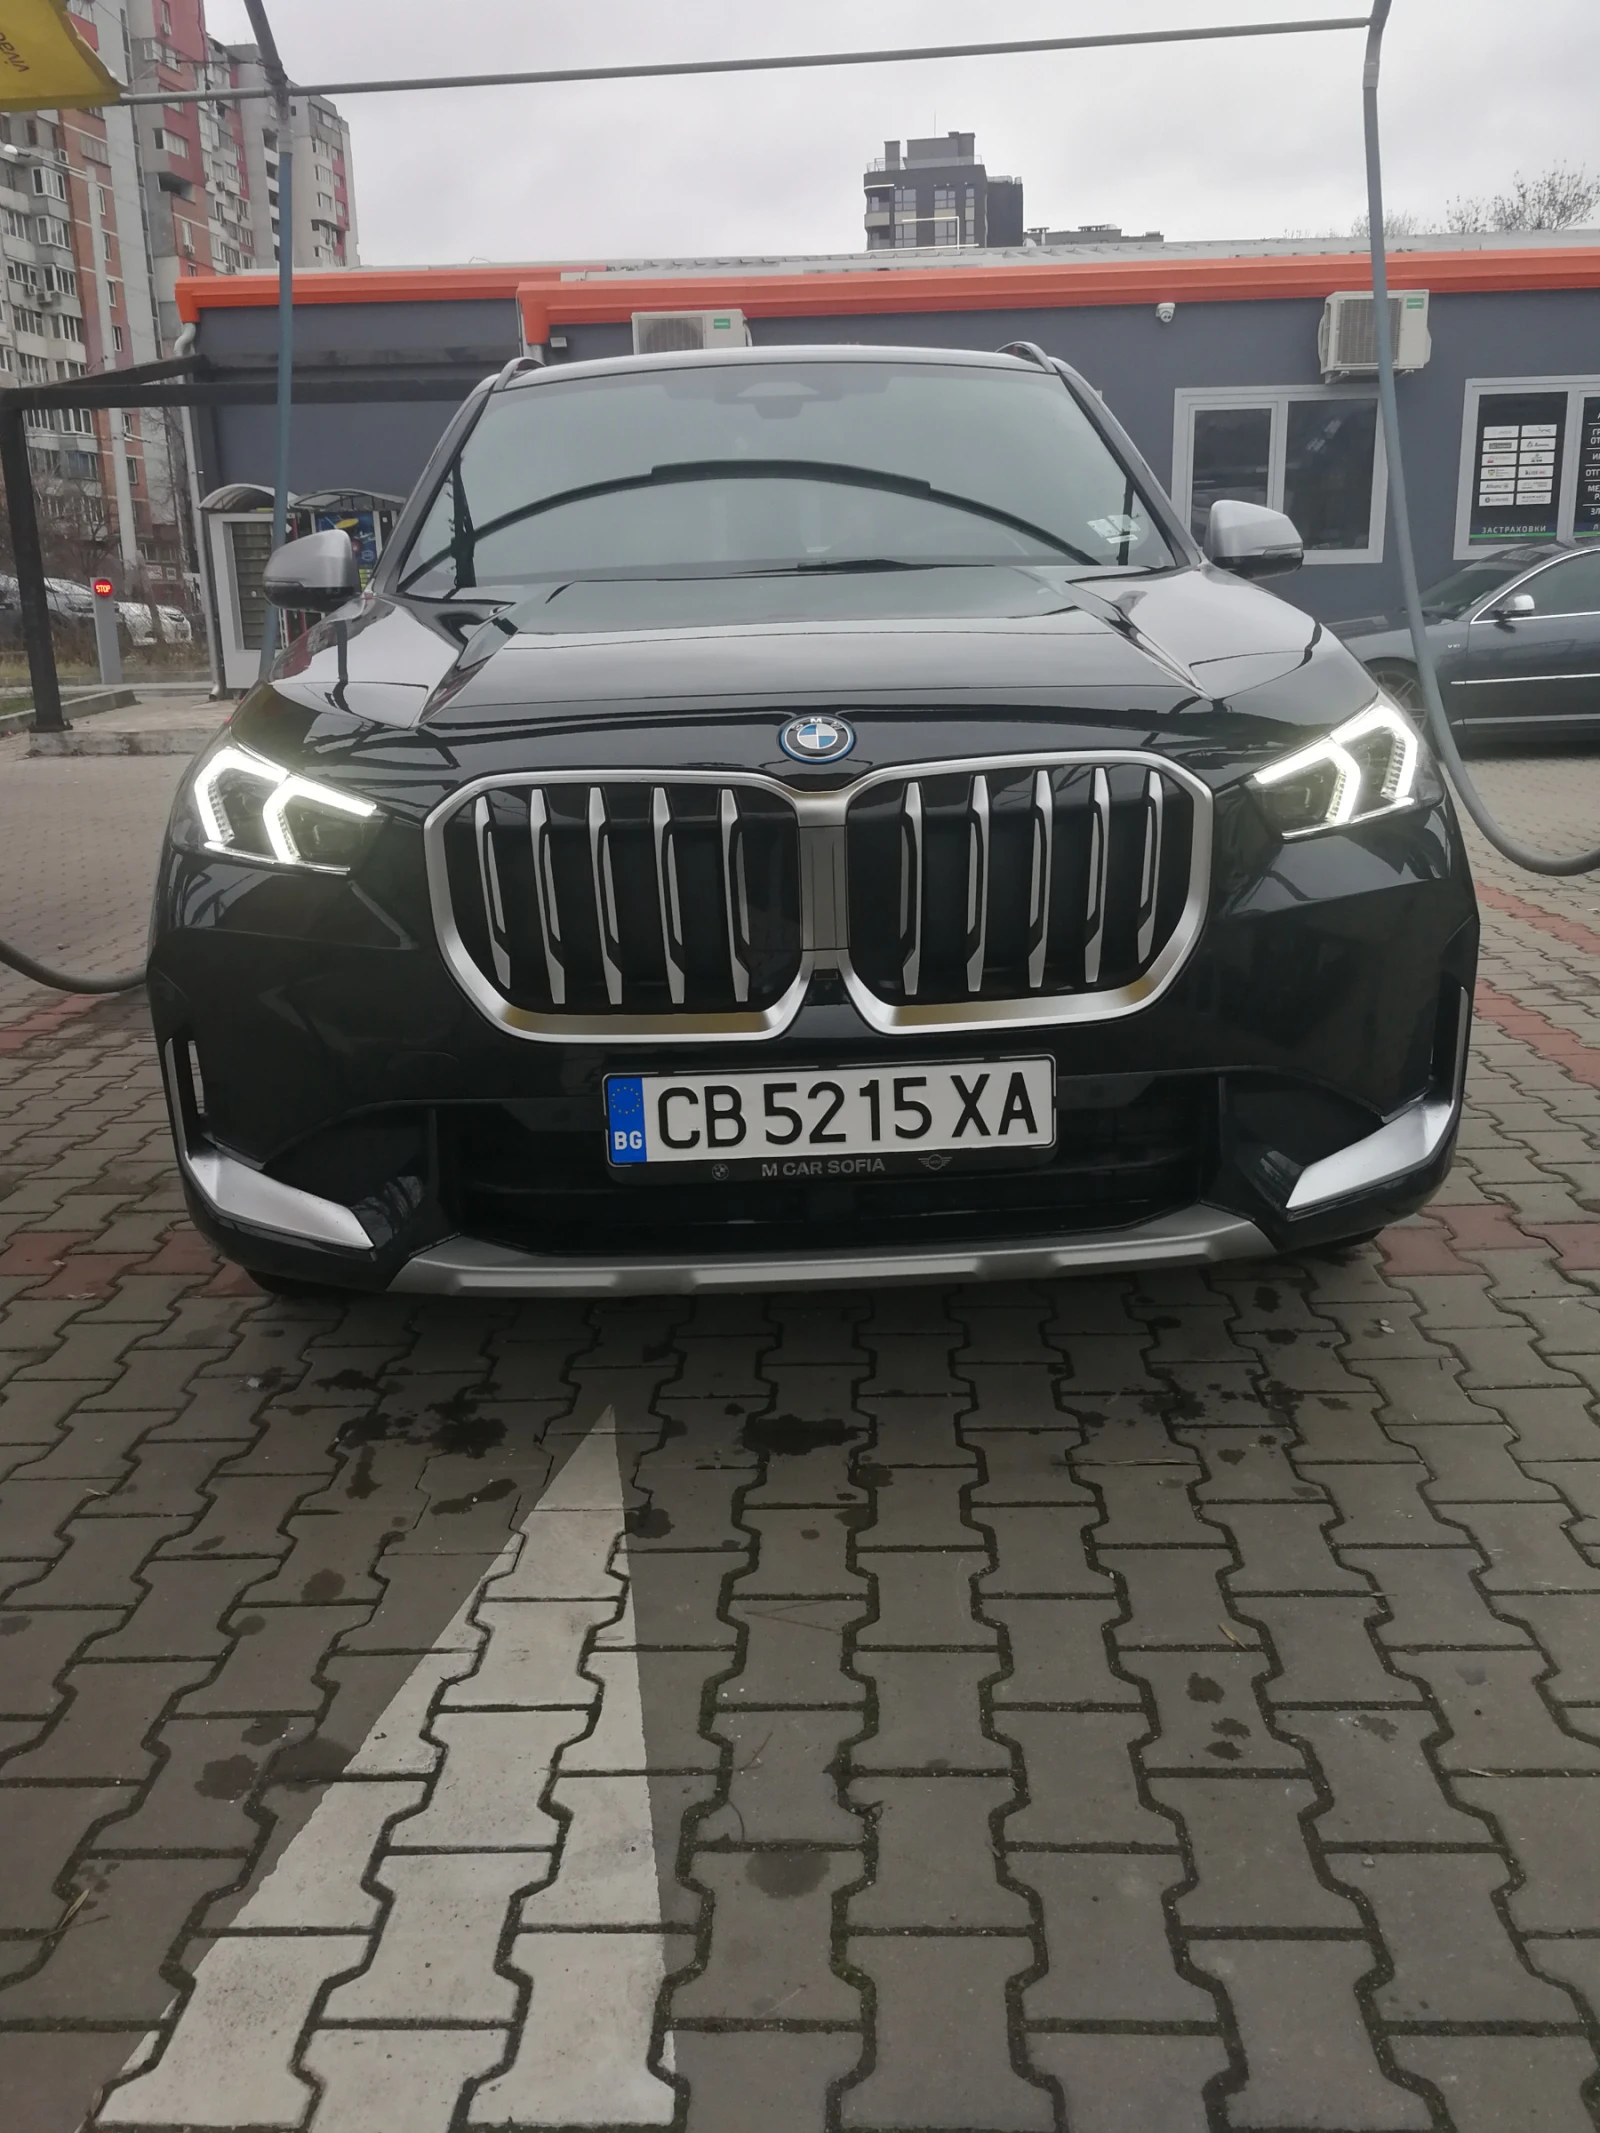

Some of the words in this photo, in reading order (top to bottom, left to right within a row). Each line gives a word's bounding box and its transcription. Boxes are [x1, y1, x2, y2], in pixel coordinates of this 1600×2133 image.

[1481, 525, 1546, 534] ЗАСТРАХОВКИ
[96, 585, 110, 593] STOP
[657, 1085, 747, 1150] CB
[763, 1076, 933, 1145] 5215
[950, 1071, 1038, 1138] XA
[614, 1130, 643, 1151] BG
[761, 1163, 778, 1177] M
[782, 1161, 823, 1176] CAR
[827, 1158, 886, 1174] SOFIA
